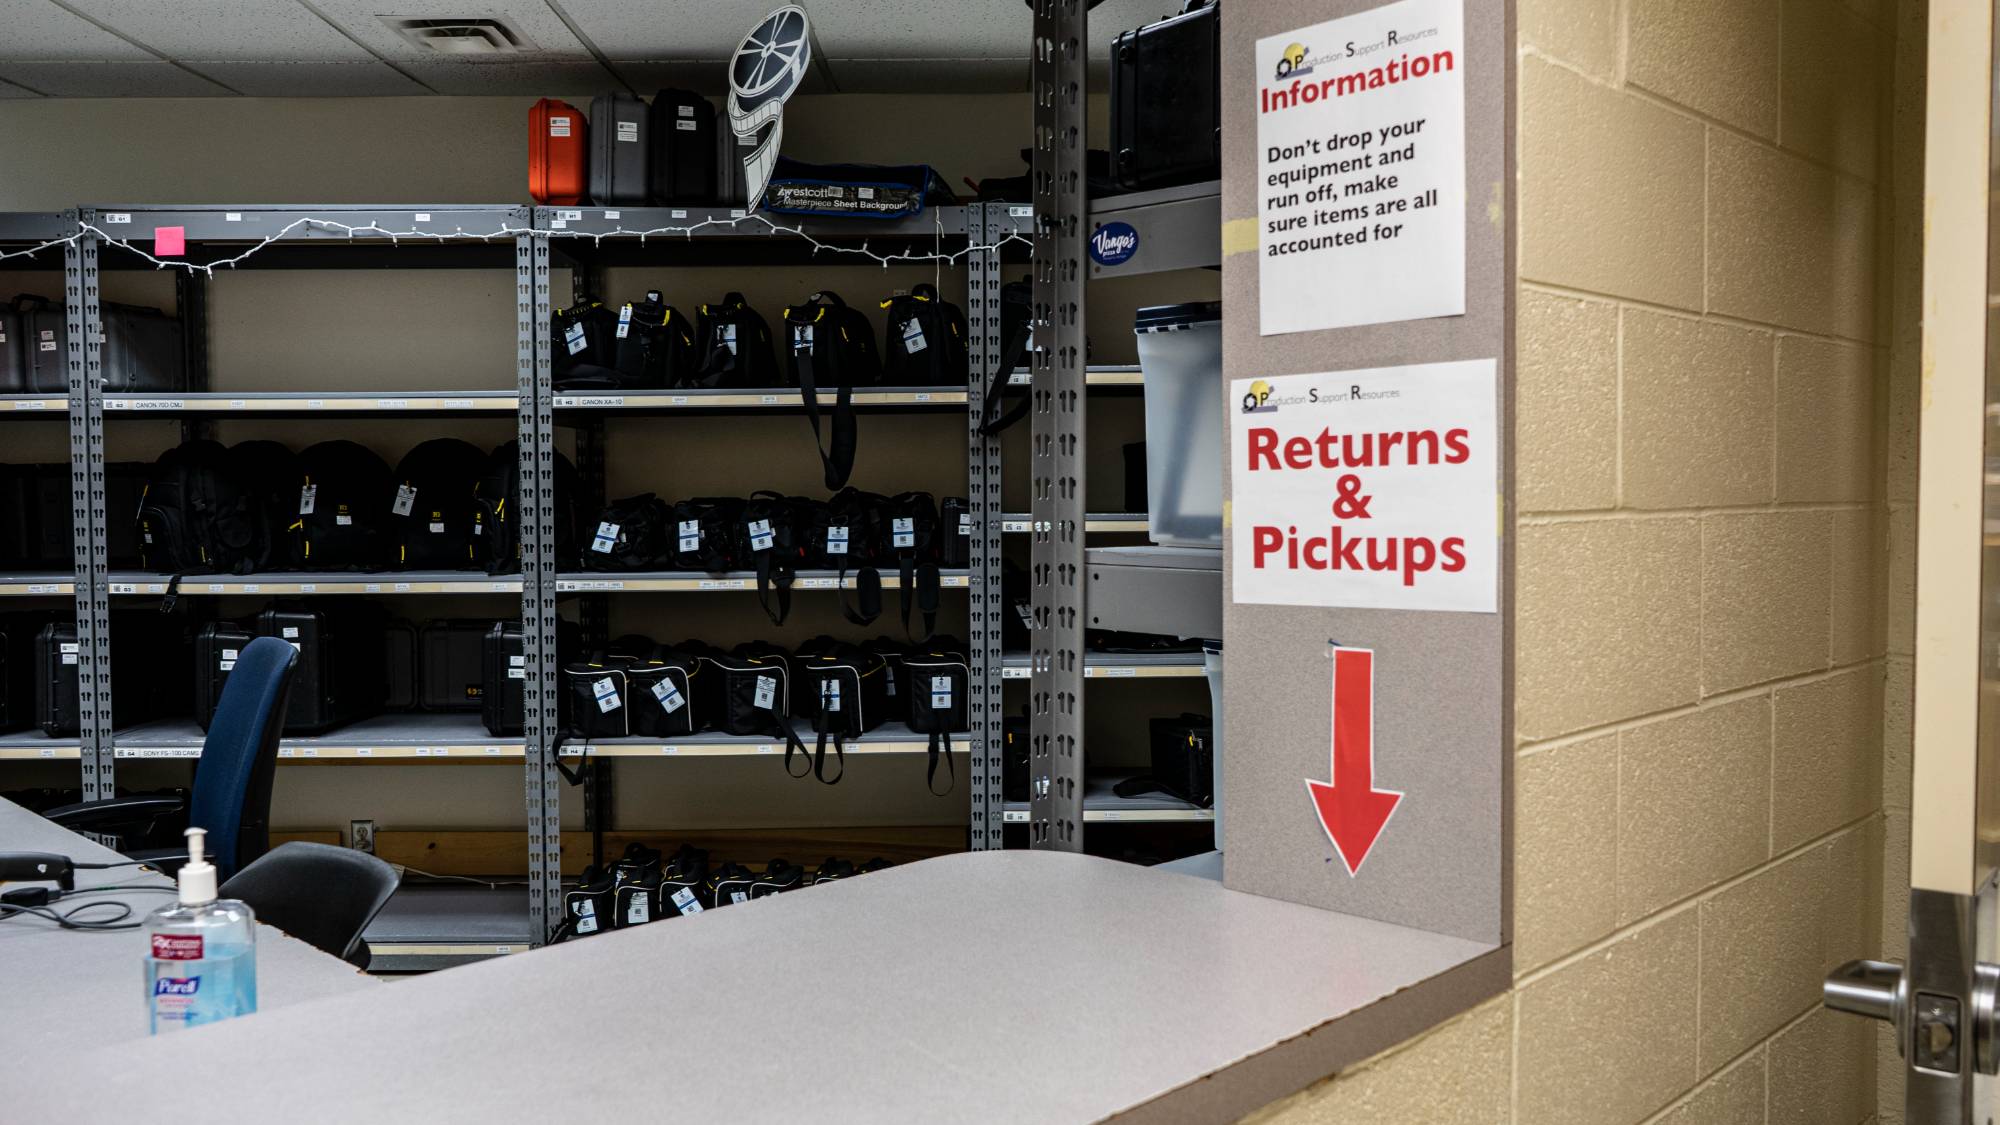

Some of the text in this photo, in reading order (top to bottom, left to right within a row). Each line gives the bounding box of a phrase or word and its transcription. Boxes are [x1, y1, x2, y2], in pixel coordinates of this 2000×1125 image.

[1345, 41, 1386, 58] Support
[1387, 27, 1438, 47] Resources
[1261, 49, 1454, 113] Information
[1267, 117, 1426, 163] Don't drop your
[1267, 143, 1415, 188] equipment and
[783, 197, 832, 208] Masterpiece
[833, 199, 858, 209] Sheet
[1267, 174, 1399, 210] run off, make
[1268, 189, 1438, 233] sure items are all
[1092, 230, 1136, 254] Vango's
[1268, 222, 1404, 257] accounted for
[1309, 388, 1348, 404] Support
[1350, 384, 1400, 400] Resources
[1247, 426, 1471, 471] Returns
[1332, 473, 1372, 520] &
[1252, 525, 1467, 587] Pickups
